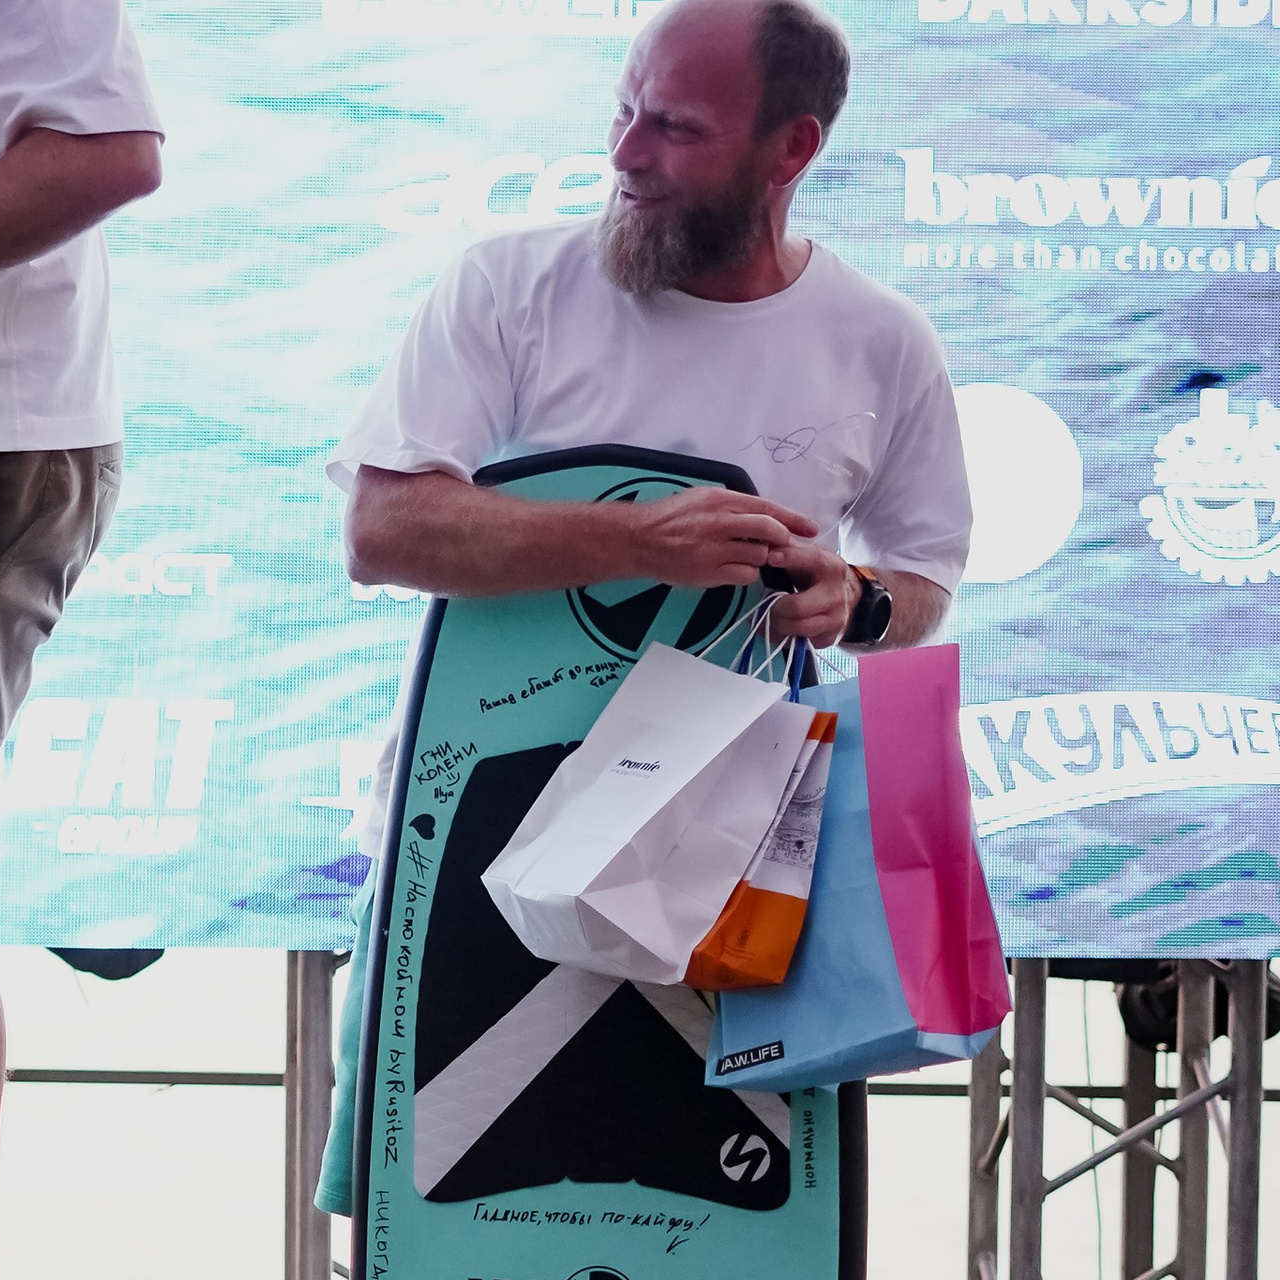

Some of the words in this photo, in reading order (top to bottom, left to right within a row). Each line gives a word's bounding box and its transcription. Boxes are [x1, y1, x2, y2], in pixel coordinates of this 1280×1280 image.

[904, 242, 998, 268] more
[1013, 238, 1101, 270] than
[414, 741, 478, 786] КОЛЕНИ
[420, 740, 454, 767] ГНИ
[966, 702, 1280, 800] КУЛЬЧЕ
